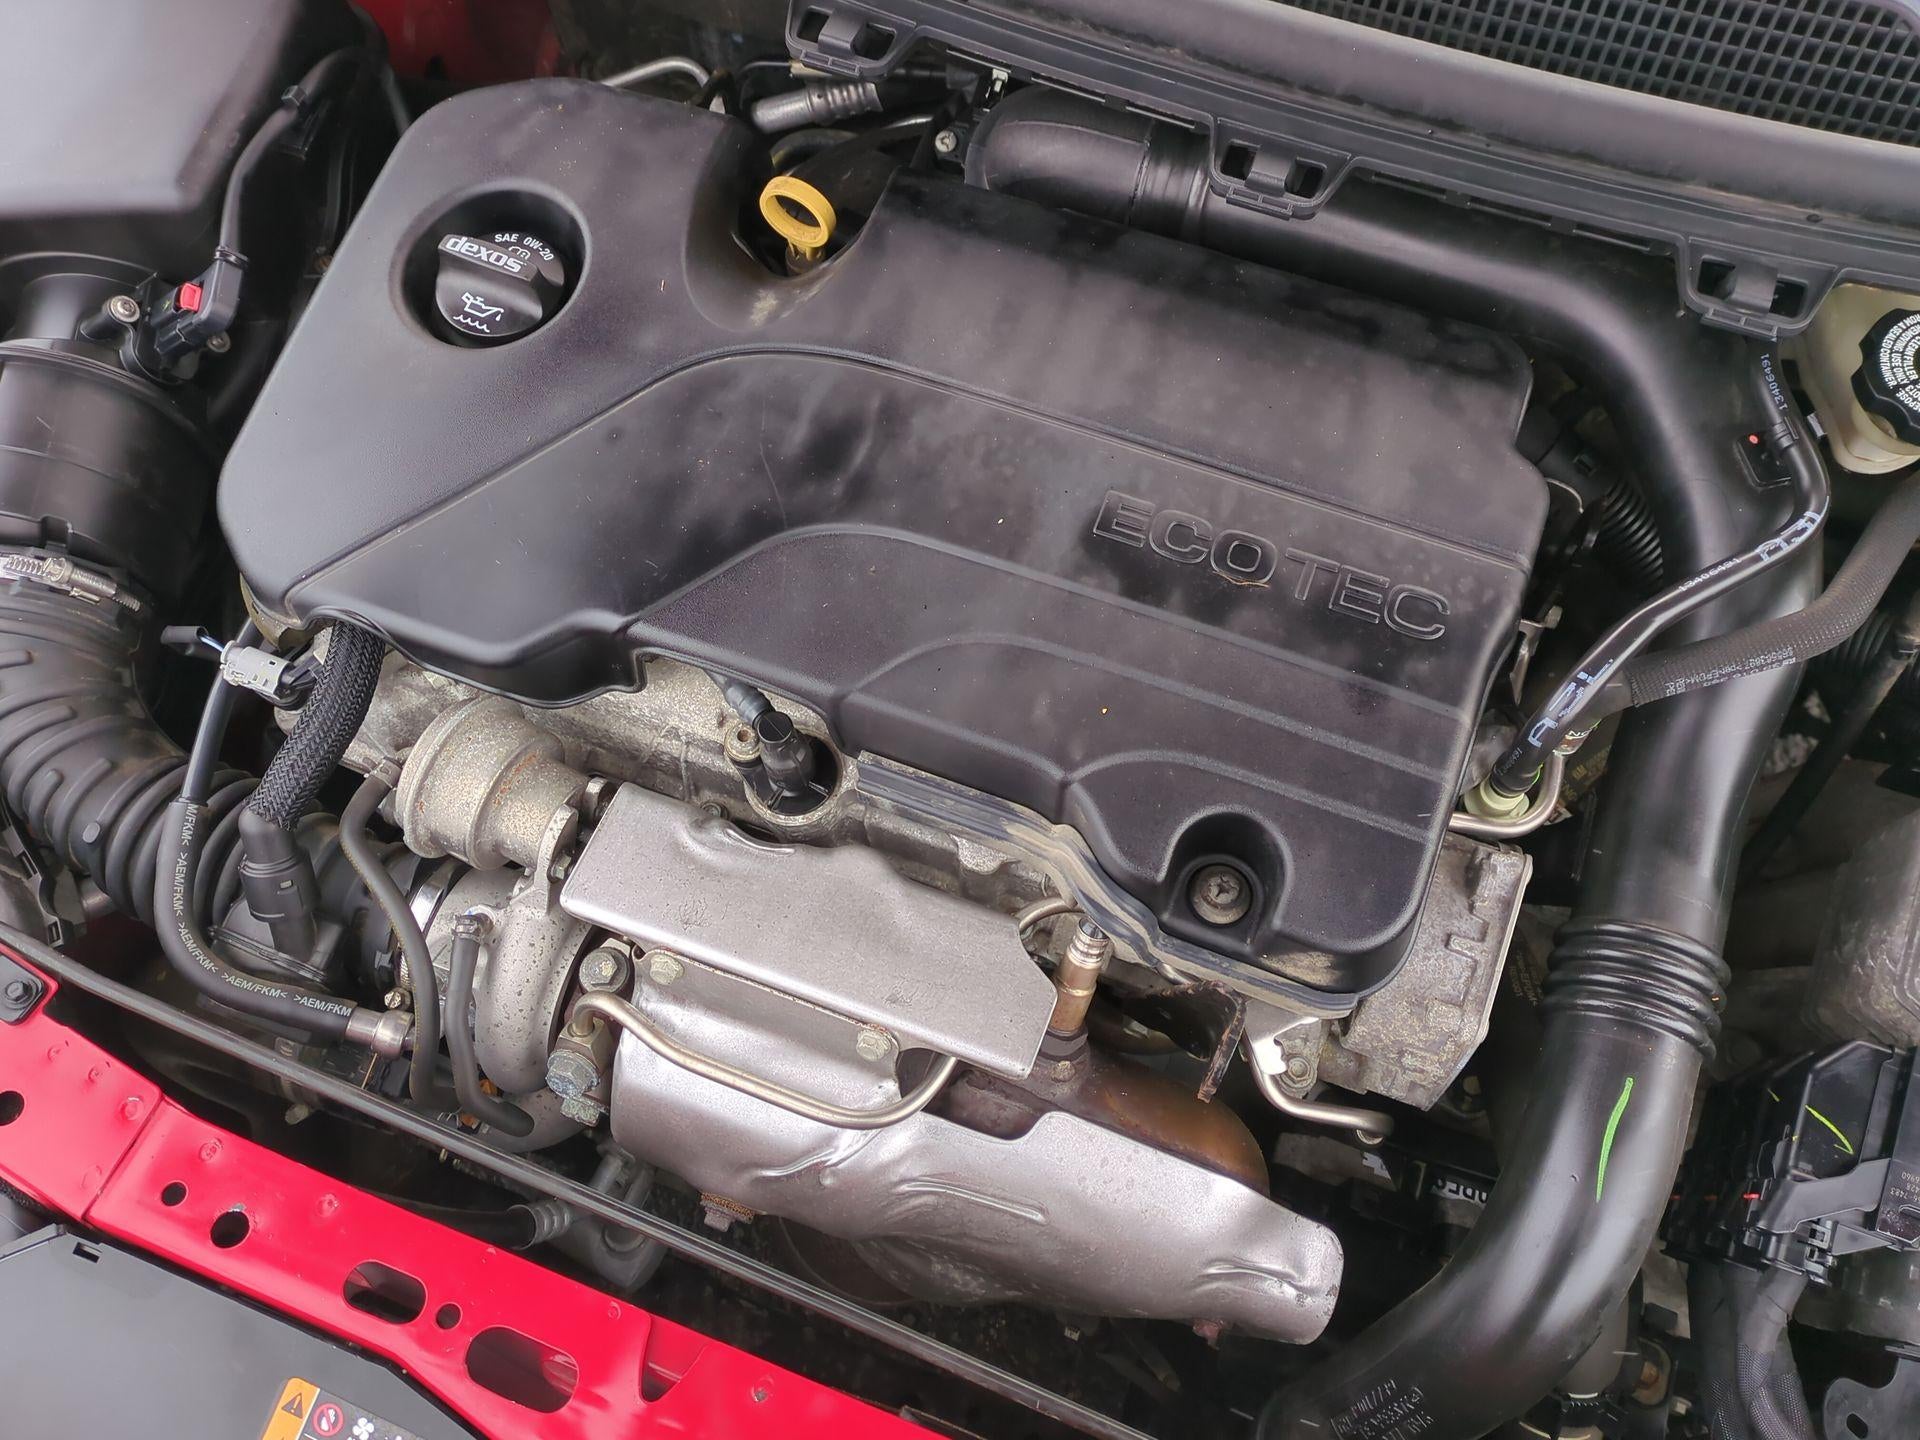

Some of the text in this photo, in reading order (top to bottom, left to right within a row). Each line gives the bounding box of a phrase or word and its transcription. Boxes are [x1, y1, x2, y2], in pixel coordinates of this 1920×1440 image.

[445, 236, 523, 273] dexos
[494, 233, 554, 261] SAE 0W-20
[1882, 325, 1900, 348] SEALED
[1891, 353, 1902, 367] USE
[1903, 356, 1918, 381] FILLER
[1760, 353, 1788, 410] 13406491
[1893, 367, 1910, 385] ONLY
[1093, 489, 1450, 641] ECOTEC
[172, 852, 189, 917] >AEM/FKM<
[177, 921, 220, 974] >AEM/FKM<
[221, 971, 289, 999] >AEM/FKM<
